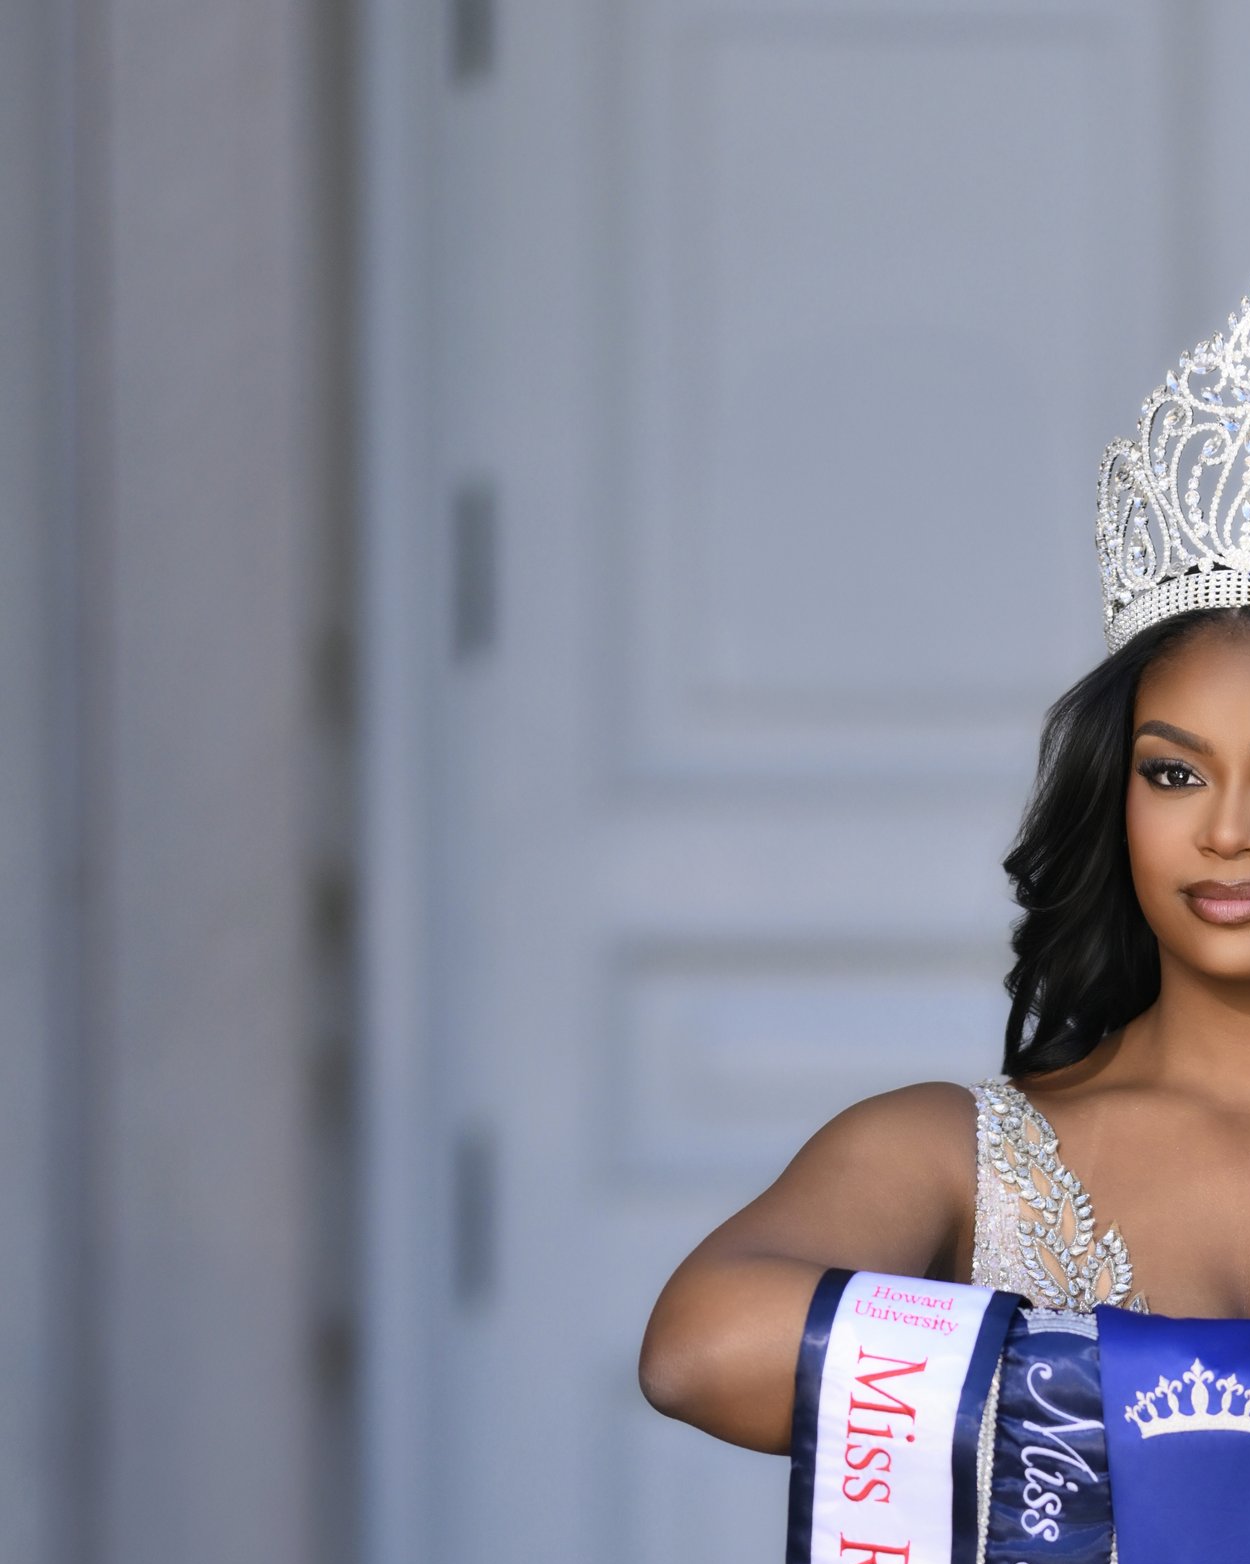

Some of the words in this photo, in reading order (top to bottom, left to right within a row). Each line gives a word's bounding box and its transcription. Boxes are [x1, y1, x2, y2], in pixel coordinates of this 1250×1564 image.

[855, 1300, 959, 1336] University
[872, 1285, 955, 1311] Howard
[842, 1344, 928, 1505] Miss
[1020, 1361, 1105, 1543] Miss
